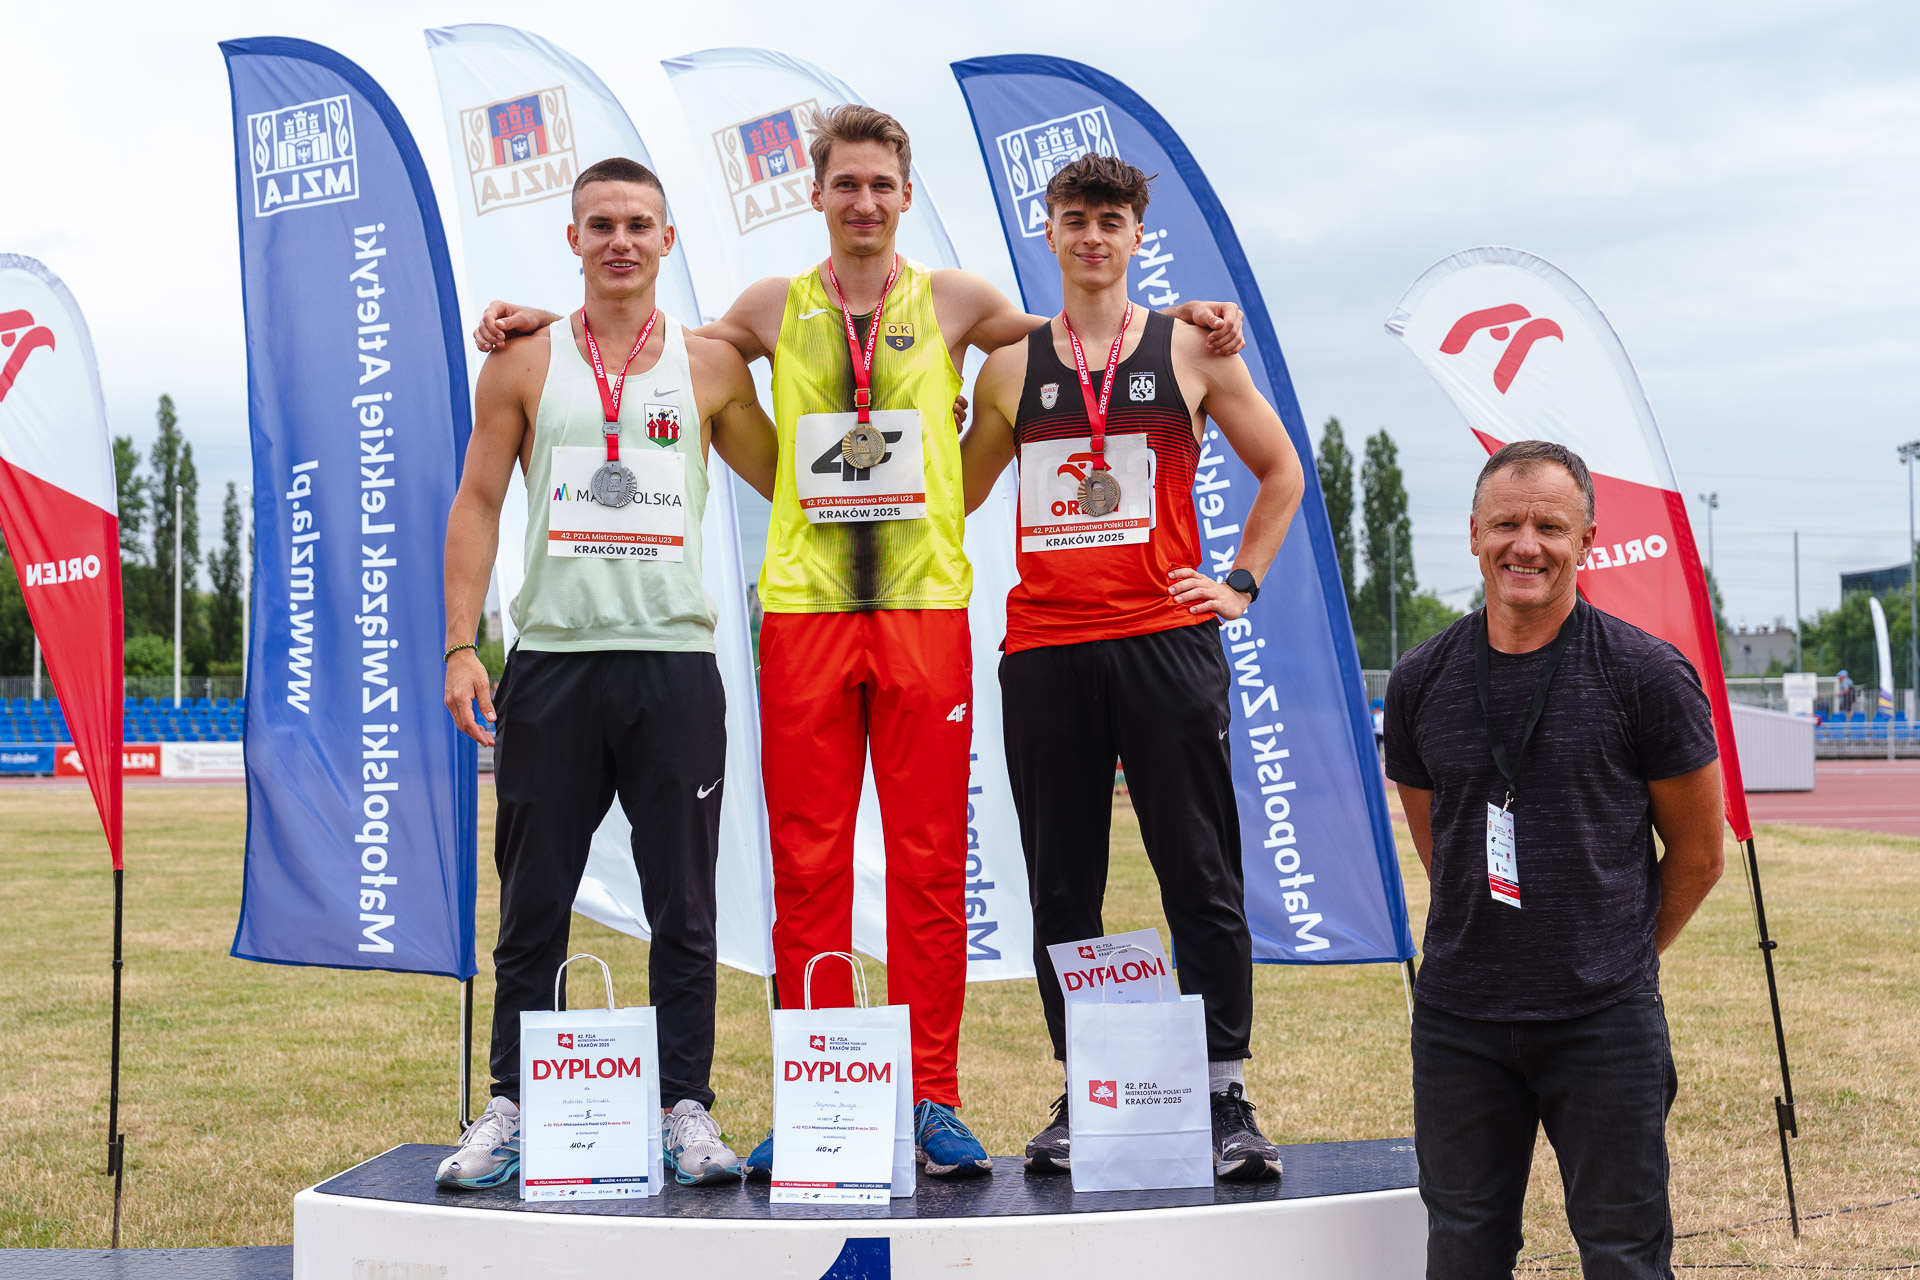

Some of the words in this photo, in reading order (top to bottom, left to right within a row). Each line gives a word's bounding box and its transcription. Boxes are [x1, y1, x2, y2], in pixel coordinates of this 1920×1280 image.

[1103, 363, 1115, 394] POLSKI
[1099, 394, 1108, 415] 2025
[835, 497, 877, 505] Mistrzostwa
[878, 495, 899, 503] Polski
[900, 494, 914, 502] U23
[818, 508, 871, 519] KRAKÓW
[872, 507, 901, 517] 2025
[1044, 525, 1061, 533] PZLA
[1061, 523, 1103, 532] Mistrzostwa
[1103, 521, 1124, 529] Polski
[592, 533, 635, 542] Mistrzostwa
[636, 535, 657, 543] Polski
[658, 536, 672, 544] U23
[1045, 534, 1096, 547] KRAKÓW
[1098, 532, 1125, 543] 2025
[574, 544, 627, 555] KRAKÓW
[630, 547, 658, 556] 2025
[946, 702, 967, 722] 4F
[122, 753, 155, 769] LEN
[1063, 957, 1166, 992] DYPLOM
[532, 1057, 641, 1080] DYPLOM
[784, 1060, 891, 1083] DYPLOM
[1124, 1082, 1137, 1090] 42.
[1138, 1082, 1158, 1090] PZLA
[1125, 1096, 1161, 1105] KRAKÓW
[1163, 1096, 1182, 1104] 2025
